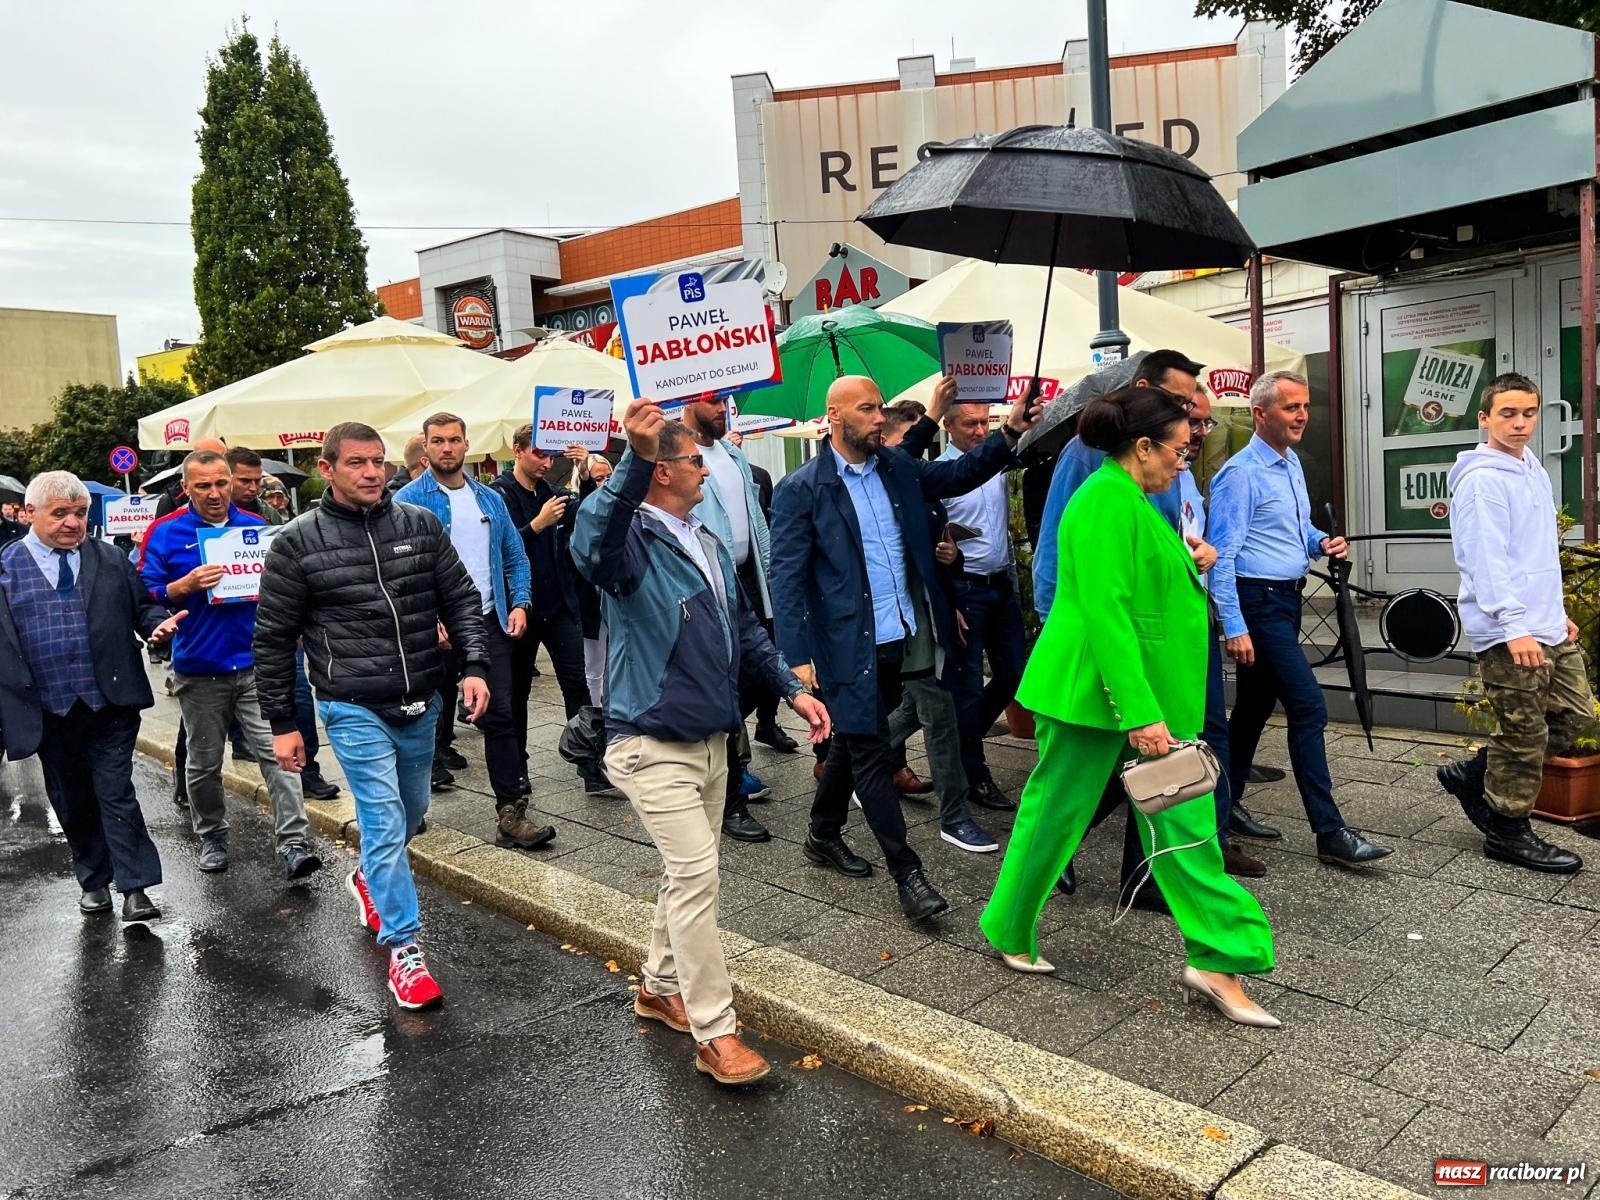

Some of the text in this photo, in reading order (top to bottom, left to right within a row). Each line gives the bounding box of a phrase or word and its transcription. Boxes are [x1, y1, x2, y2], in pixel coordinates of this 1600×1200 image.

[815, 263, 881, 311] BAR
[460, 316, 491, 327] WARKA
[668, 308, 730, 331] PAWEŁ
[636, 324, 767, 366] JABŁOŃSKI
[965, 349, 994, 359] PAWEŁ
[656, 361, 759, 389] KANDYDAT DO SEJMU!
[947, 360, 1009, 376] JABŁOŃSKI
[1213, 370, 1250, 391] ŻYWIEC
[1420, 388, 1456, 402] JASNE
[561, 409, 593, 418] PAWEŁ
[539, 419, 608, 432] JABŁOŃSKI
[1405, 471, 1452, 501] ŁOM
[107, 513, 154, 523] JABŁOŃS
[234, 550, 267, 560] PAWE
[221, 562, 264, 576] ABŁO
